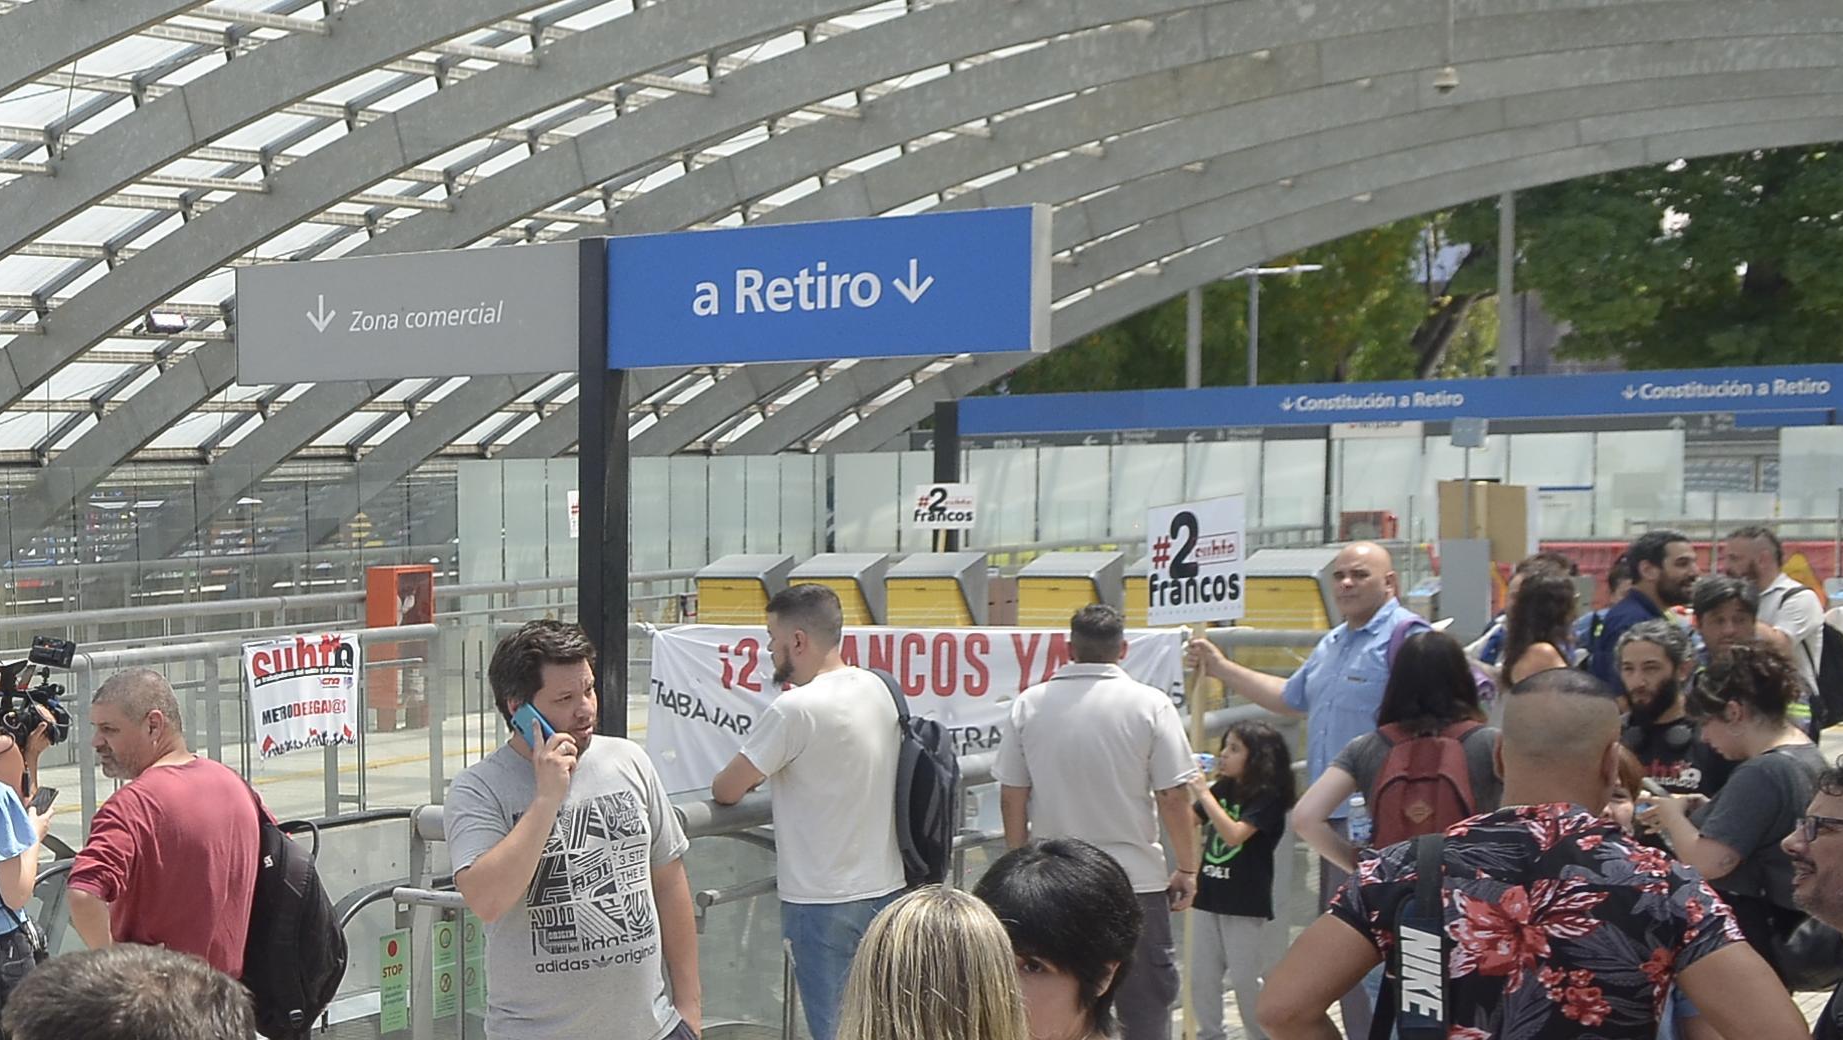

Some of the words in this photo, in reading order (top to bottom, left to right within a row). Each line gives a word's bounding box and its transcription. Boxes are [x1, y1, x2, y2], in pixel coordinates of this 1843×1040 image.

[693, 282, 720, 316] a
[735, 261, 882, 315] Retiro
[349, 309, 399, 332] Zona
[404, 300, 504, 329] comercial
[1294, 392, 1396, 412] Constitución
[1398, 394, 1410, 408] a
[1412, 389, 1464, 407] Retiro
[1638, 379, 1754, 400] Constitución
[1756, 383, 1769, 396] a
[1772, 377, 1831, 396] Retiro
[918, 487, 948, 513] #2
[1153, 511, 1198, 579] #2
[781, 632, 990, 697] ANCOS
[618, 854, 626, 865] 3
[620, 869, 638, 883] THE
[382, 963, 404, 978] STOP
[535, 958, 590, 973] adidas
[614, 942, 657, 964] origina
[1399, 925, 1443, 1022] NIKE
